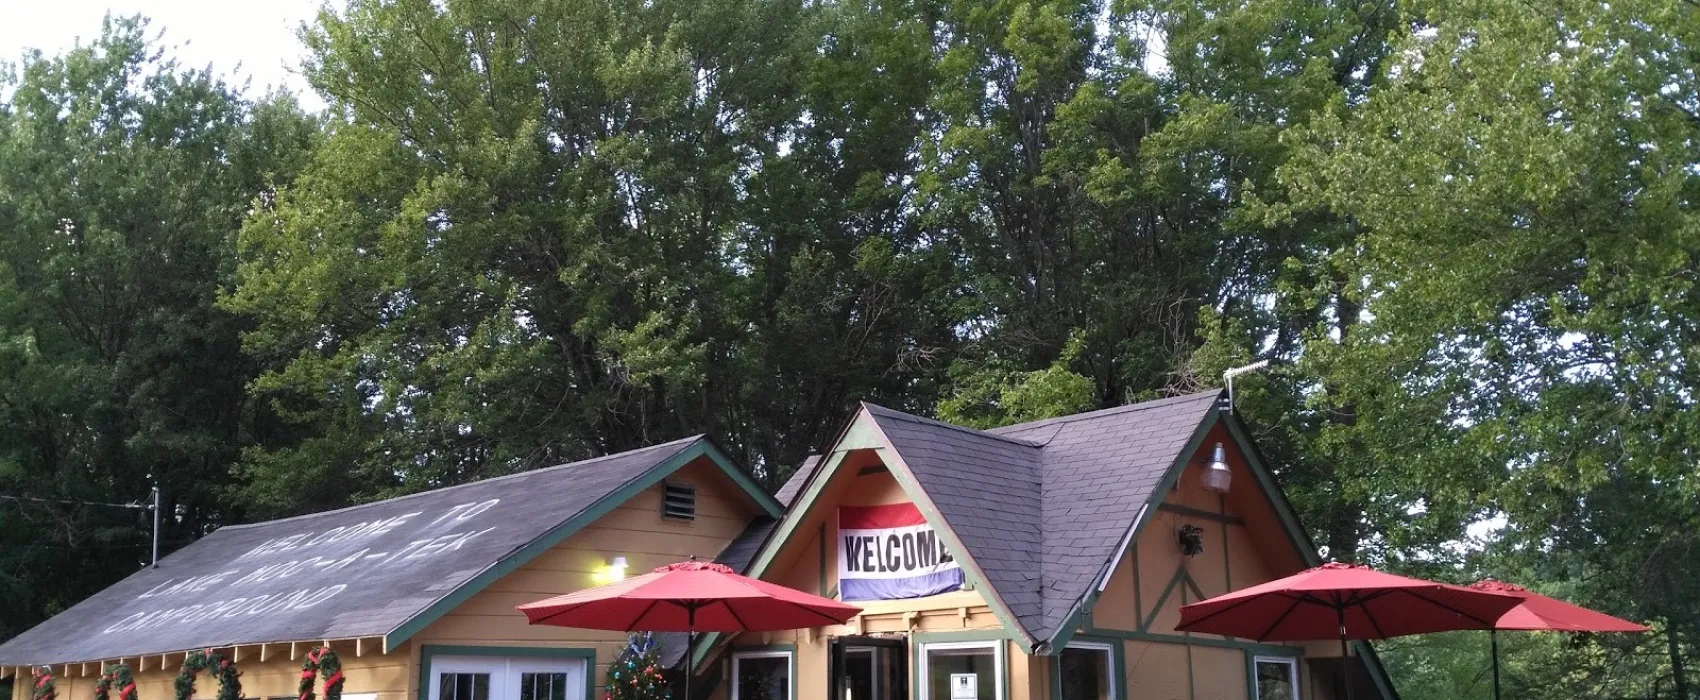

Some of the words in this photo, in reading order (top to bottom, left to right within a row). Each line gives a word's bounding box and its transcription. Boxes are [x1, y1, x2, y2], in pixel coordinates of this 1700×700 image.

[237, 511, 423, 560] WELCOME
[427, 499, 500, 527] TO
[103, 584, 347, 633] CAMPGROUND
[137, 571, 239, 599] LAKE
